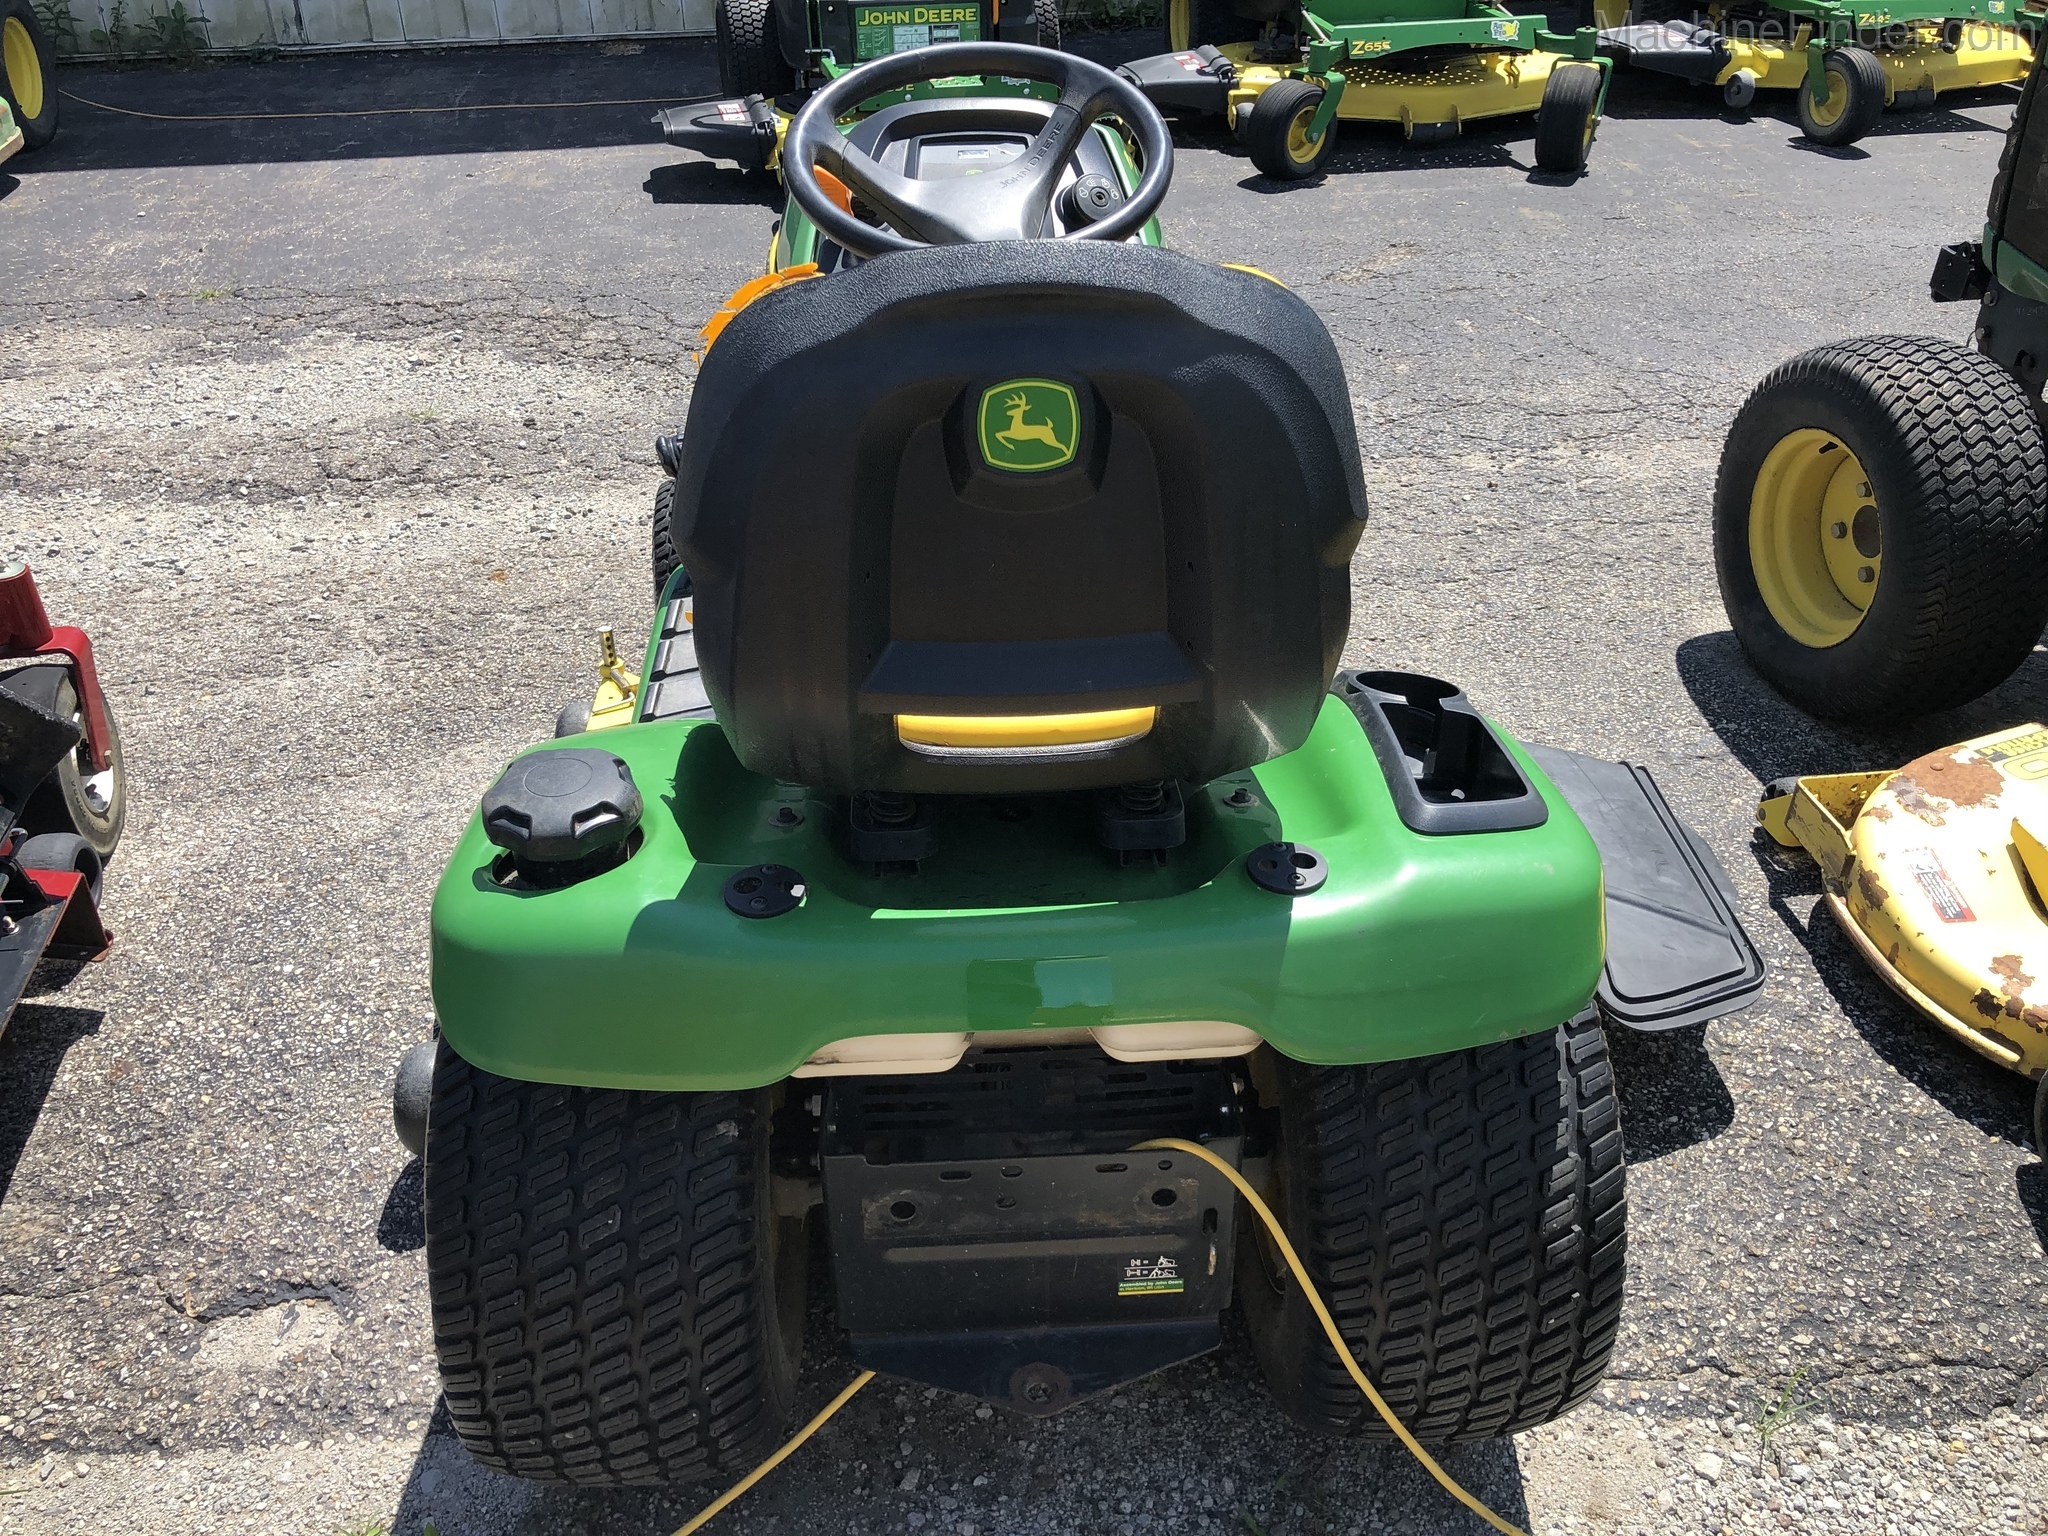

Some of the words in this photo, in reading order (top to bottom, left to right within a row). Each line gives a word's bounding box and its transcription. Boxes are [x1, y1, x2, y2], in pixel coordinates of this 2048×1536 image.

[859, 10, 910, 26] JOHN
[914, 7, 977, 23] DEERE
[1000, 167, 1031, 189] JOHN
[1027, 121, 1065, 168] DEERE
